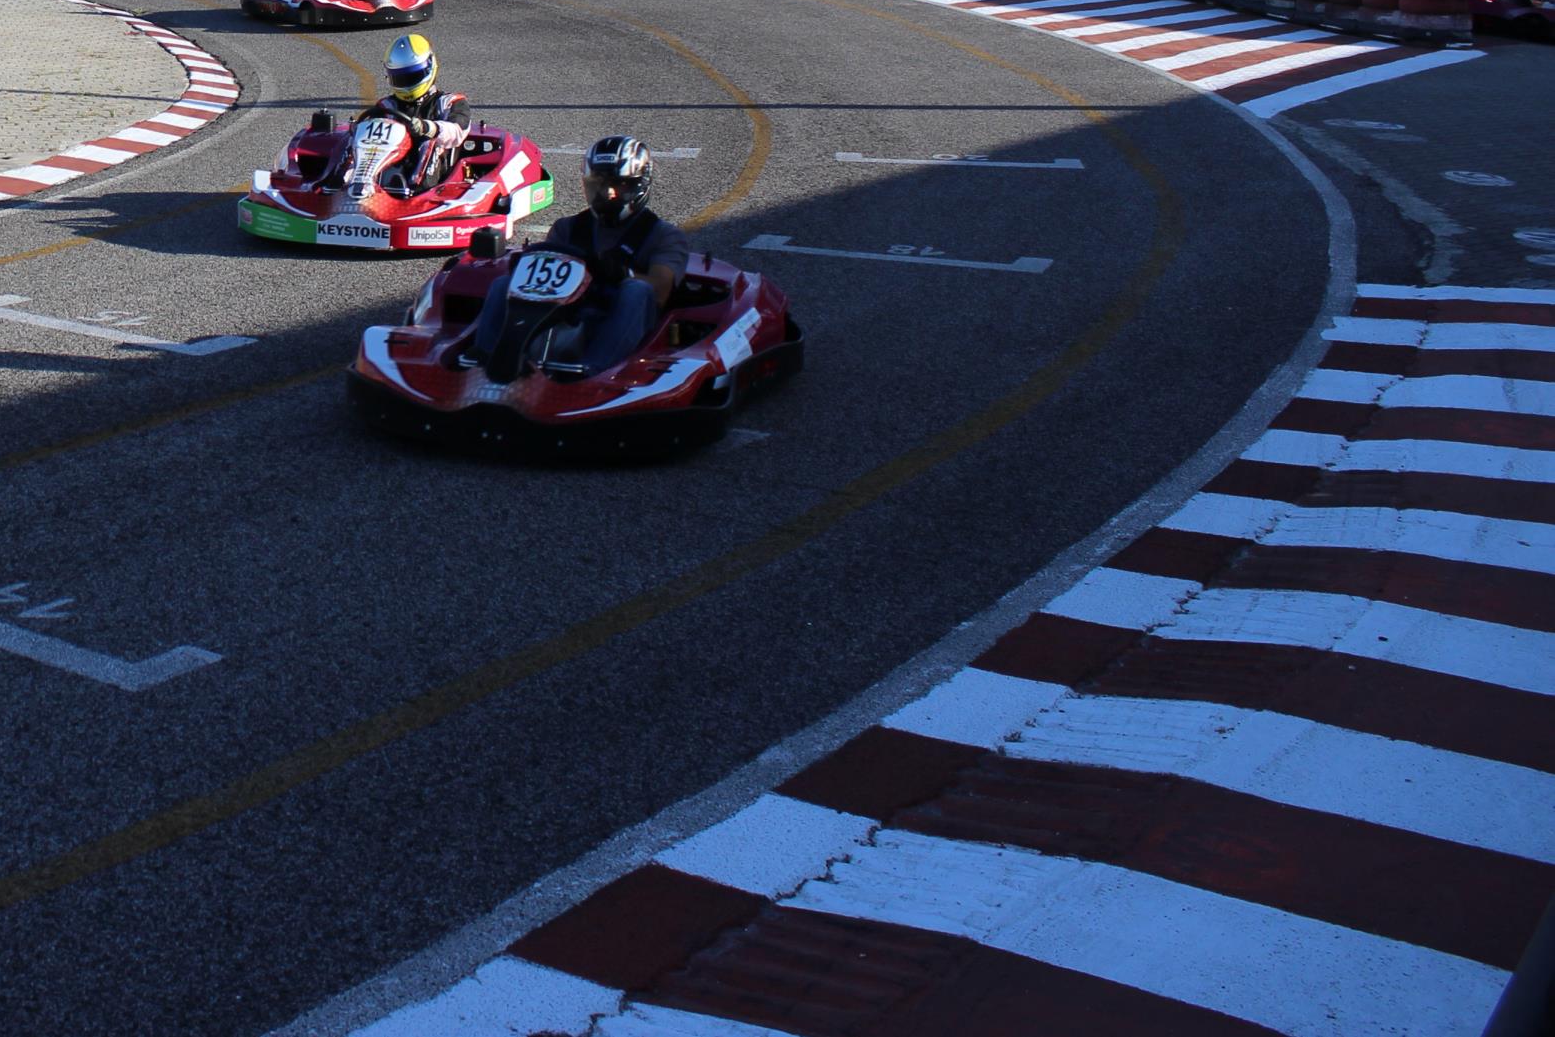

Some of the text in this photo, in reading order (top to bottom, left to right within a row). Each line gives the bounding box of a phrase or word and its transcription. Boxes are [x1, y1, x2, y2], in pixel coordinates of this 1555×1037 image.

[365, 122, 393, 140] 141
[317, 223, 390, 239] KEYSTONE
[410, 228, 451, 240] UnipolSai
[525, 257, 572, 288] 159
